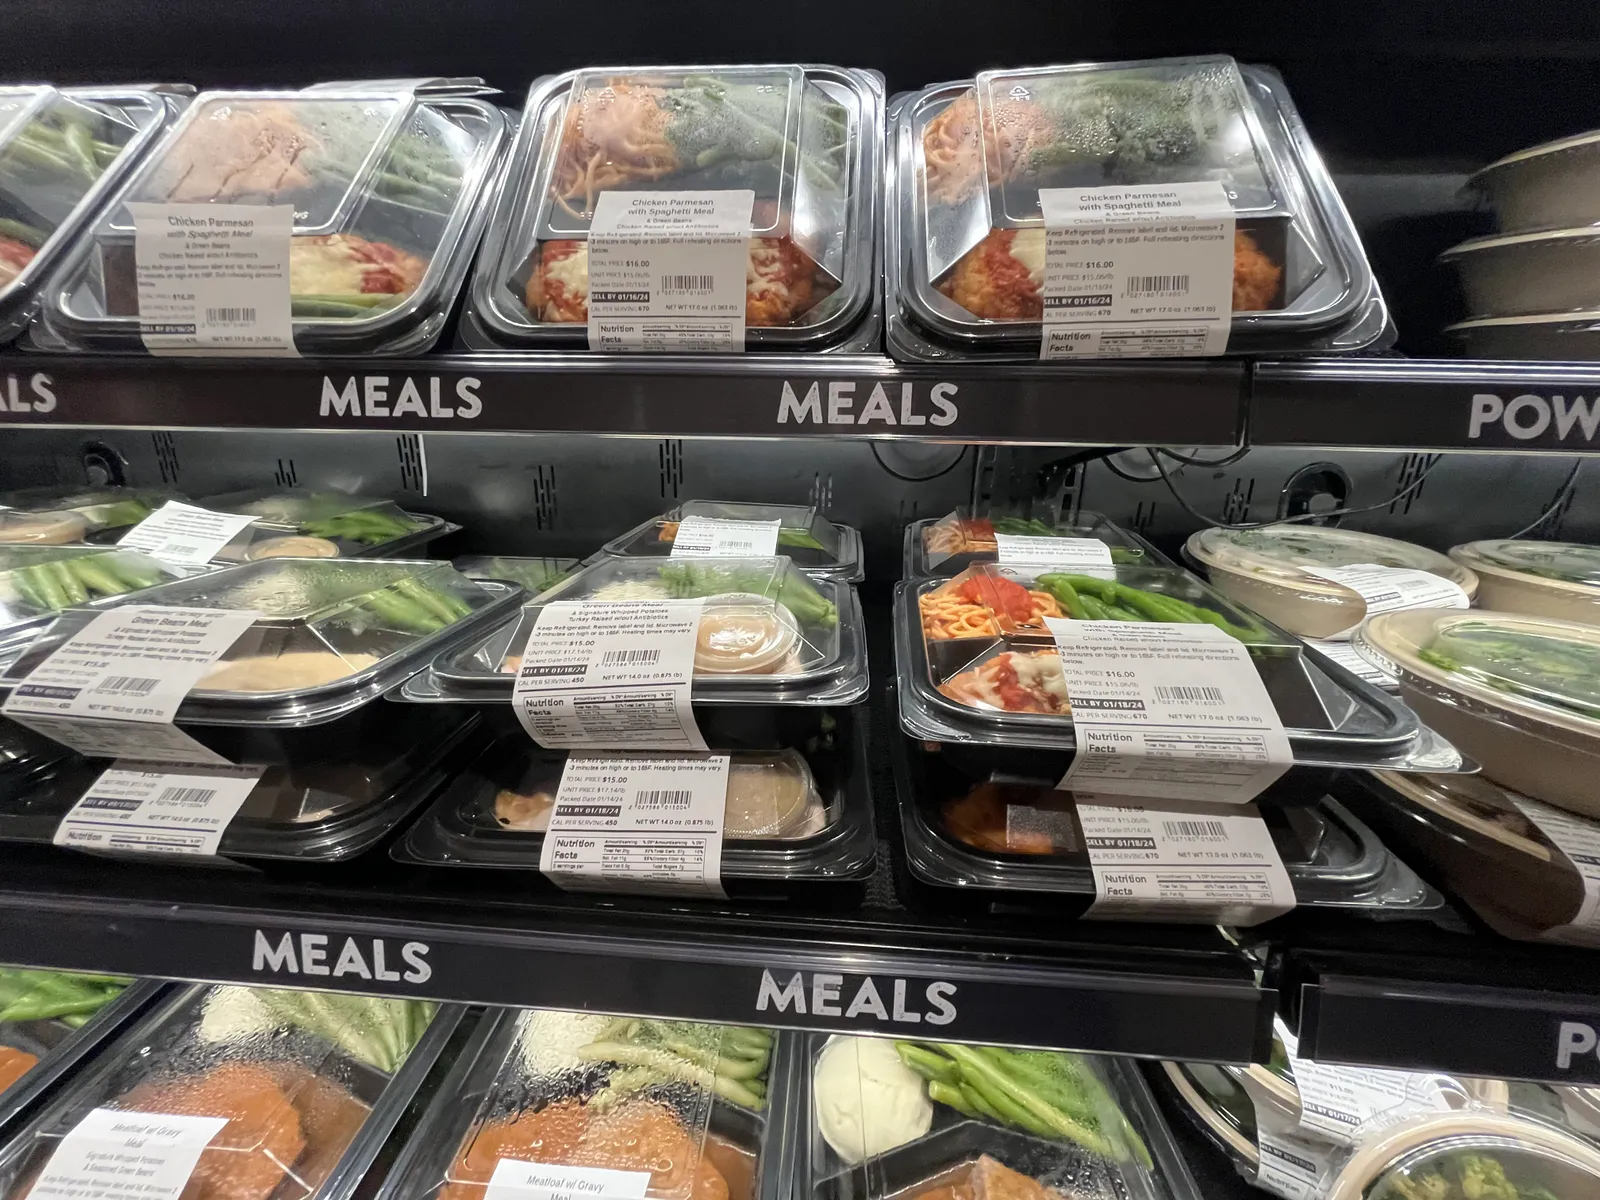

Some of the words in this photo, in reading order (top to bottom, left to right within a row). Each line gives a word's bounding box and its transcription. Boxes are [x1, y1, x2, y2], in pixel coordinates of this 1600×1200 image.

[1080, 194, 1121, 202] Chicken
[1125, 192, 1176, 200] Parmesan
[1079, 203, 1101, 211] with
[1104, 201, 1153, 211] Spaghetti
[649, 208, 691, 216] Spaghetti
[168, 216, 207, 226] Chicken
[209, 218, 253, 227] Parmesan
[626, 260, 649, 268] $16.00
[1086, 261, 1114, 269] $16.00
[618, 293, 648, 301] 01/16/24
[1062, 297, 1073, 305] BY
[1074, 297, 1110, 305] 01/16/24
[601, 325, 634, 333] Nutrition
[1052, 332, 1091, 341] Nutrition
[1050, 344, 1073, 352] Facts
[319, 375, 482, 419] MEALS
[777, 380, 958, 426] MEALS
[1468, 394, 1600, 441] POW
[551, 666, 585, 674] 01/18/24
[526, 699, 564, 707] Nutrition
[1103, 701, 1142, 709] 01/18/24
[1088, 733, 1133, 742] Nutrition
[1089, 745, 1116, 753] Facts
[557, 839, 595, 848] Nutrition
[1087, 839, 1103, 847] SELL
[1117, 839, 1154, 848] 01/18/24
[555, 851, 577, 860] Facts
[1105, 875, 1147, 884] Nutrition
[1108, 887, 1133, 896] Facts
[253, 929, 432, 984] MEALS
[756, 968, 957, 1025] MEALS
[1556, 1021, 1600, 1068] P
[527, 1175, 565, 1188] Meatloaf
[566, 1180, 576, 1189] w/
[578, 1181, 604, 1193] Gravy
